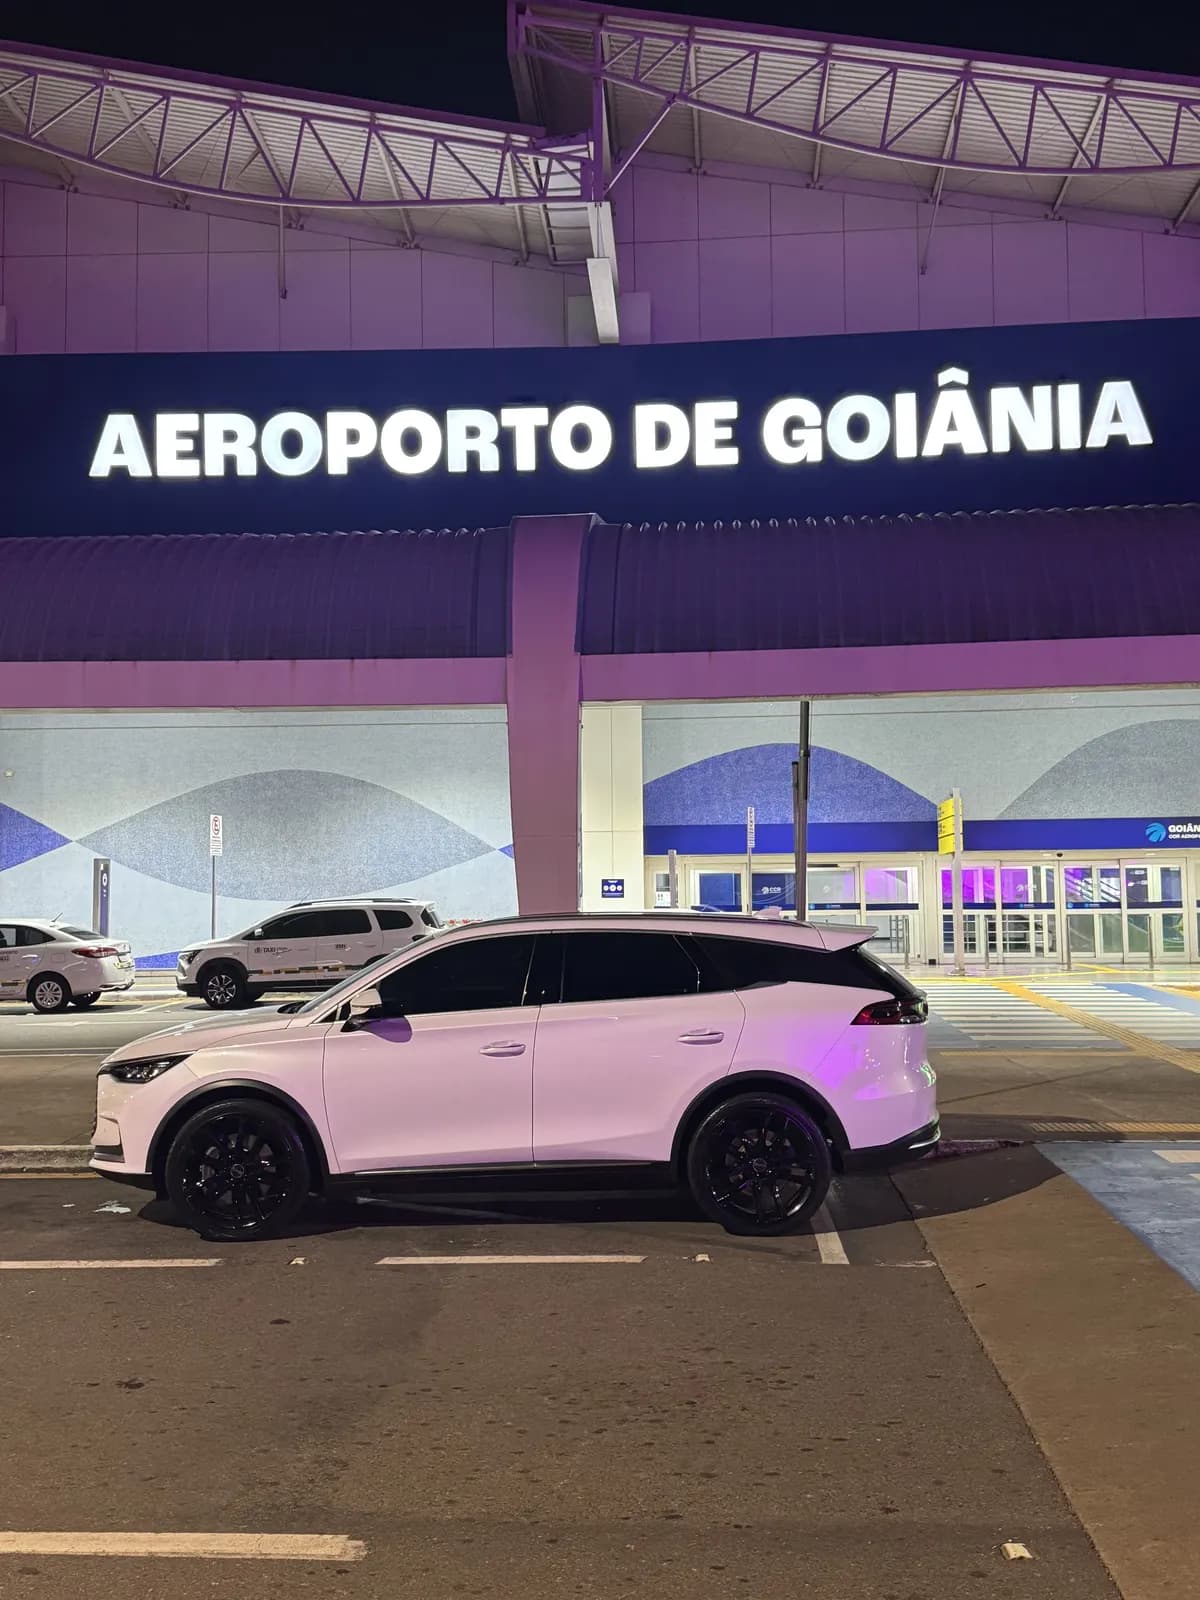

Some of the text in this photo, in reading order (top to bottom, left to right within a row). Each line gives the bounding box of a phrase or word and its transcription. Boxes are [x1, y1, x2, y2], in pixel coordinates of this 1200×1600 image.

[88, 366, 1153, 478] AEROPORTO DE GOIÂNIA
